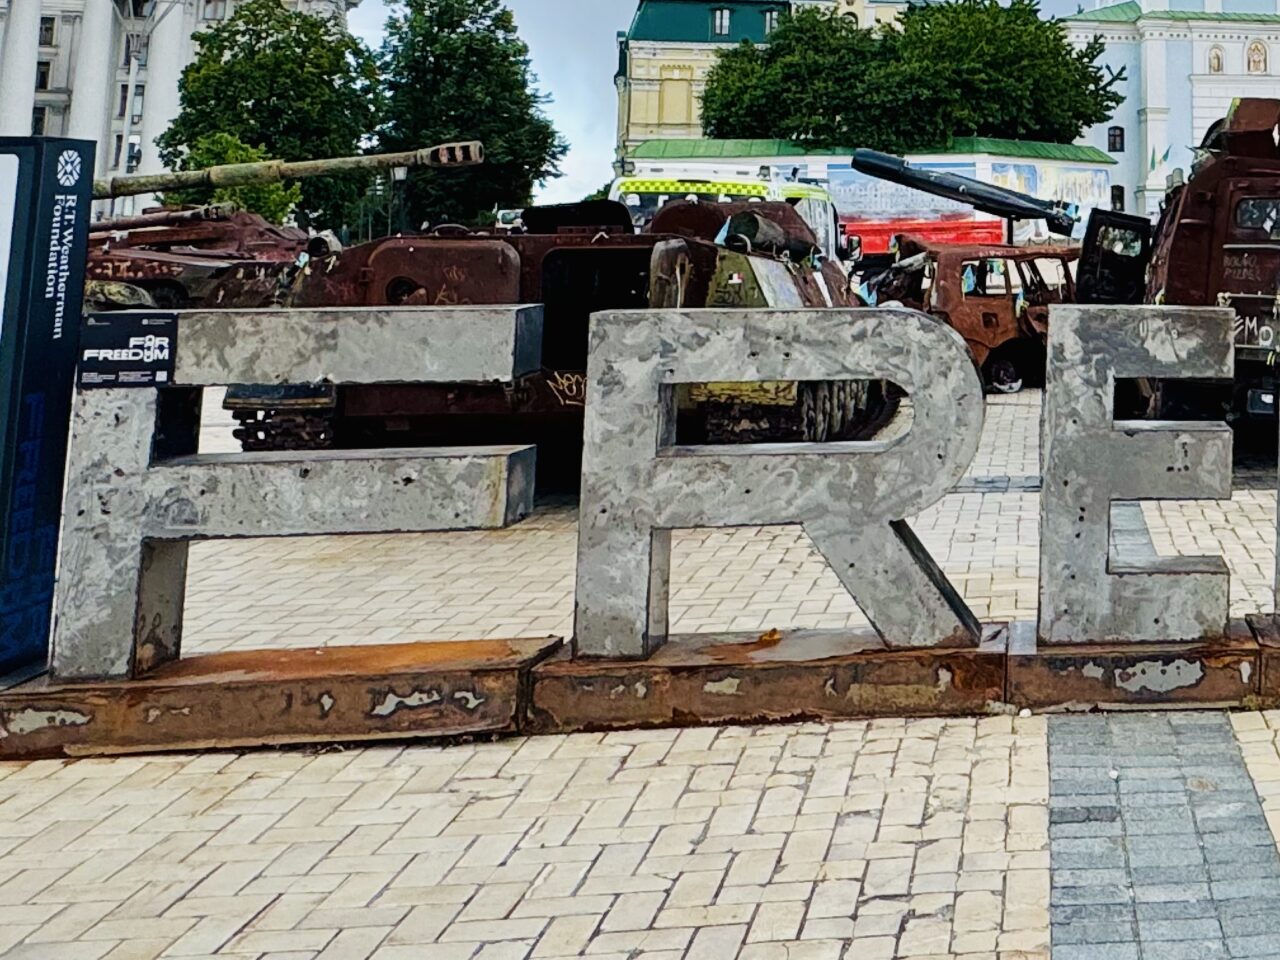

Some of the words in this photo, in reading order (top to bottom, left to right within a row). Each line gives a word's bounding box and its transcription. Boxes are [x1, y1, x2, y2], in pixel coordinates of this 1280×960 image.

[65, 194, 78, 226] R.T.
[45, 194, 66, 299] Foundation
[53, 227, 74, 339] Weatherman
[83, 348, 170, 363] FREEDOM
[129, 334, 170, 349] FOR
